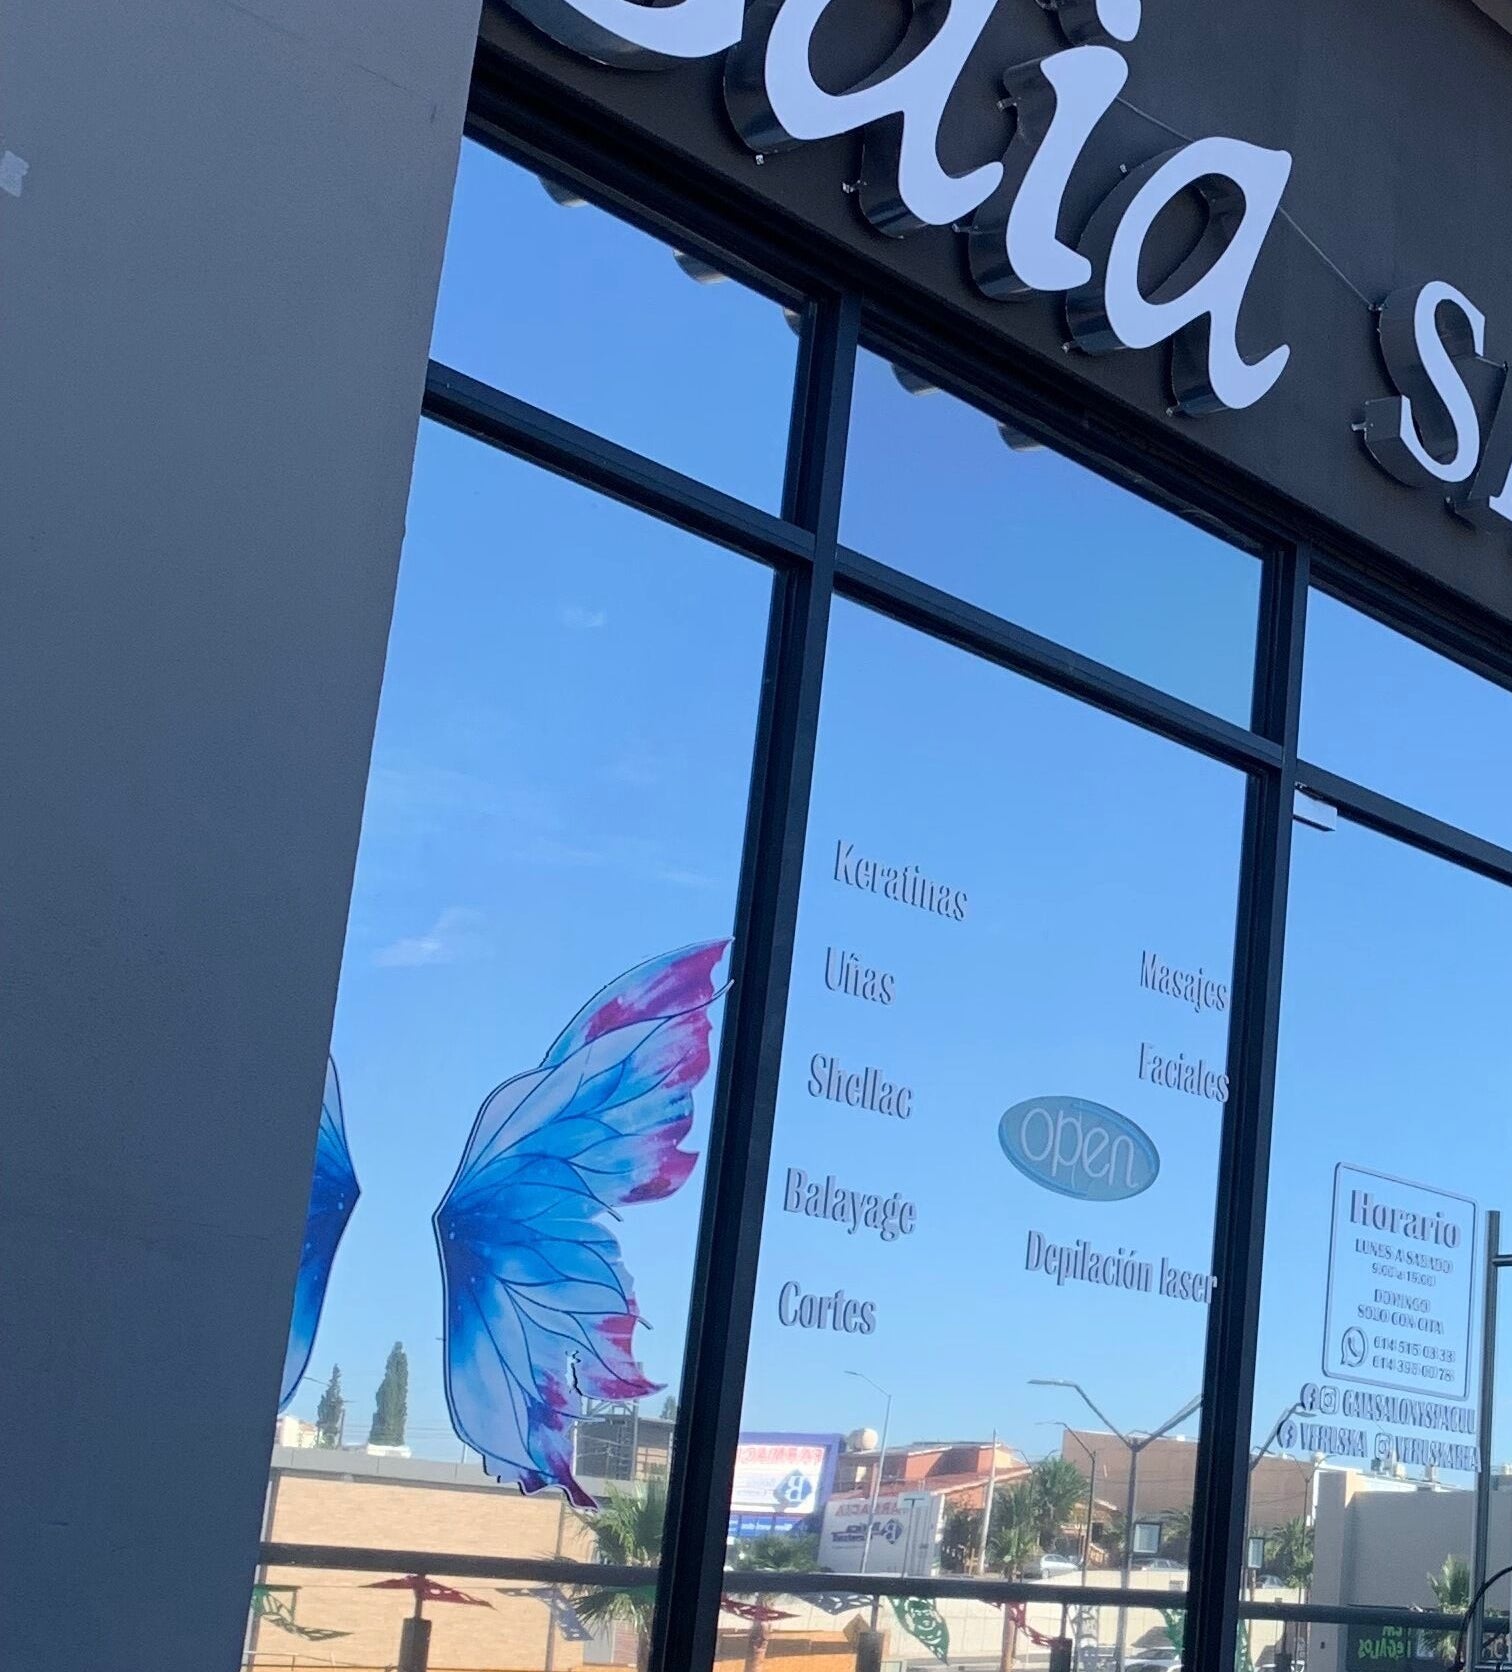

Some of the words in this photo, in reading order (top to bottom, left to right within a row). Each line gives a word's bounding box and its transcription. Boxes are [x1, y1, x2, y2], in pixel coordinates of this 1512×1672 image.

[562, 0, 1293, 409] aia
[834, 839, 968, 922] Keratinas
[824, 946, 896, 1005] Uñas
[1140, 950, 1228, 1013] Masajes
[808, 1053, 913, 1120] Shellac
[1138, 1042, 1230, 1102] Faciales
[1020, 1107, 1141, 1190] open
[783, 1168, 918, 1242] Balayage
[1350, 1189, 1461, 1249] Horario
[1025, 1230, 1153, 1293] Depilación
[1159, 1257, 1218, 1305] laser
[777, 1281, 877, 1335] Cortes
